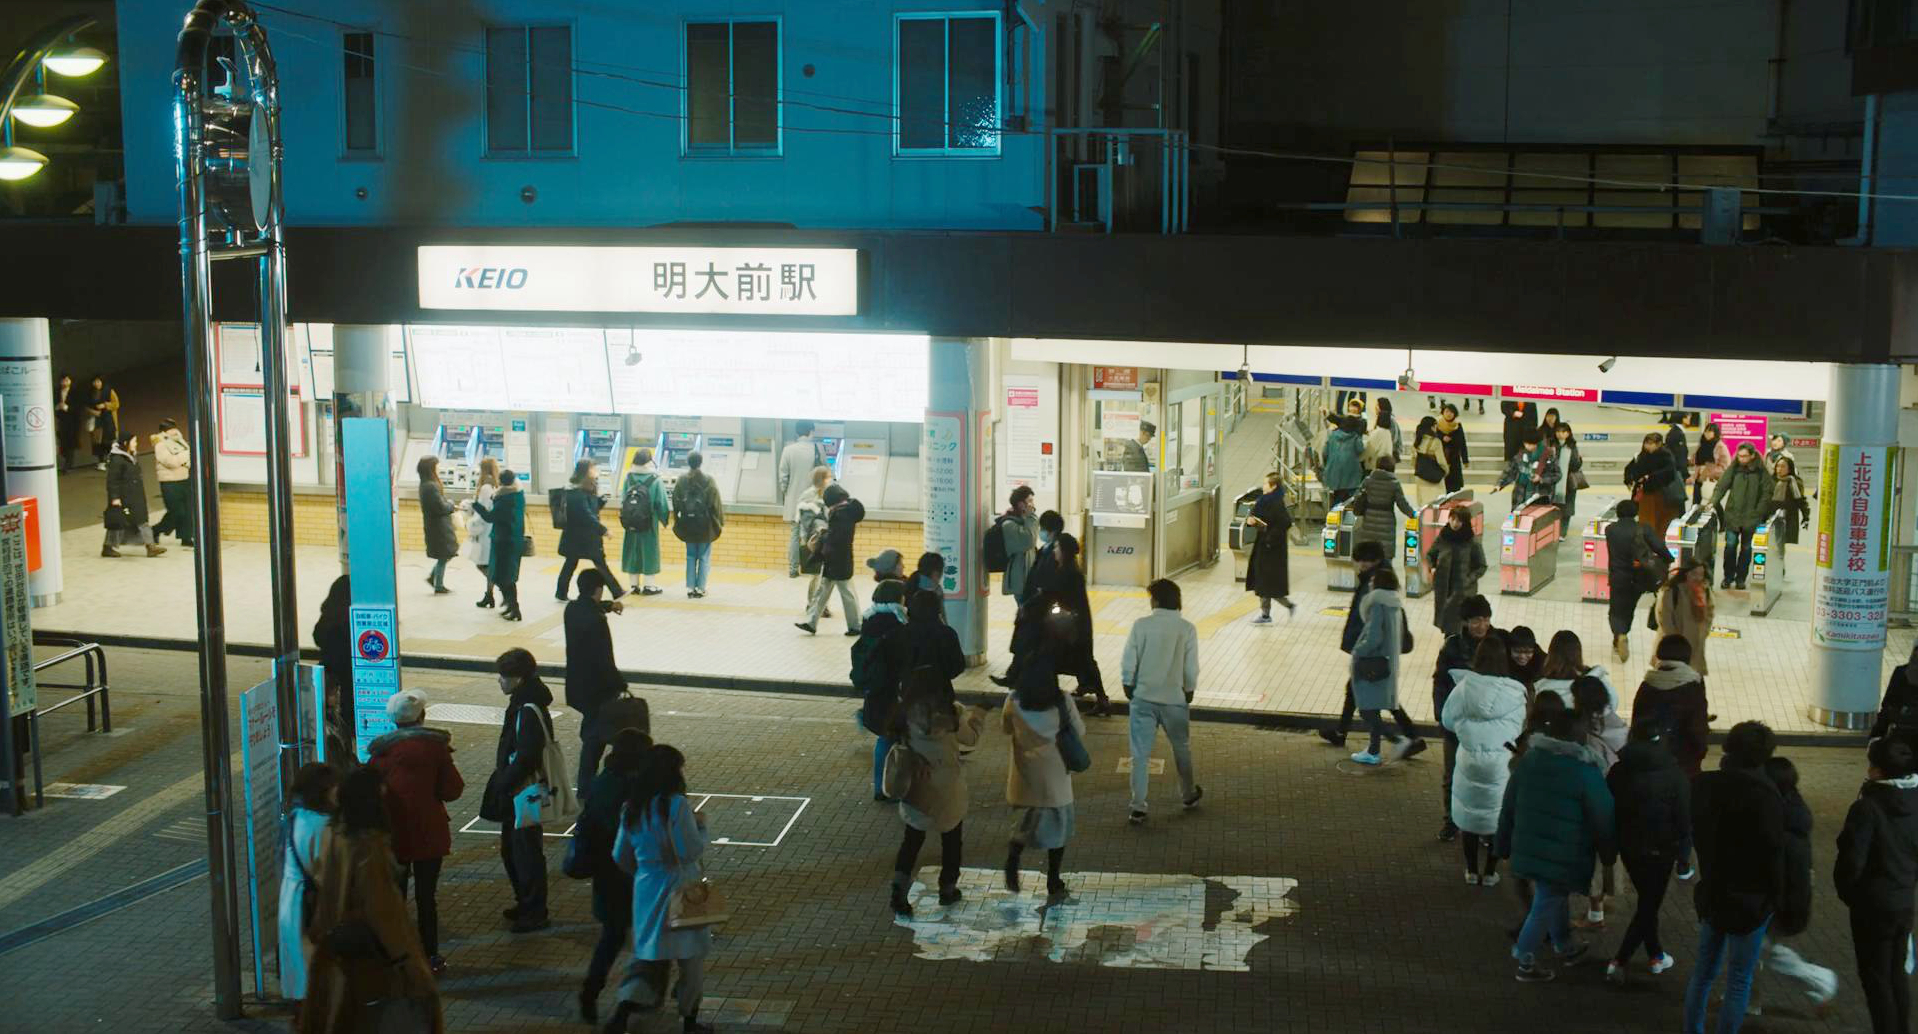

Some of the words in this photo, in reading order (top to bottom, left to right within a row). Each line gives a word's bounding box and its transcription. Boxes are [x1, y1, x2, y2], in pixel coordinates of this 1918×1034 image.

[455, 267, 529, 289] KEIO
[653, 261, 818, 302] 明大前駅
[1847, 452, 1872, 572] 上北沢自動車学校
[1107, 546, 1134, 555] KEIO
